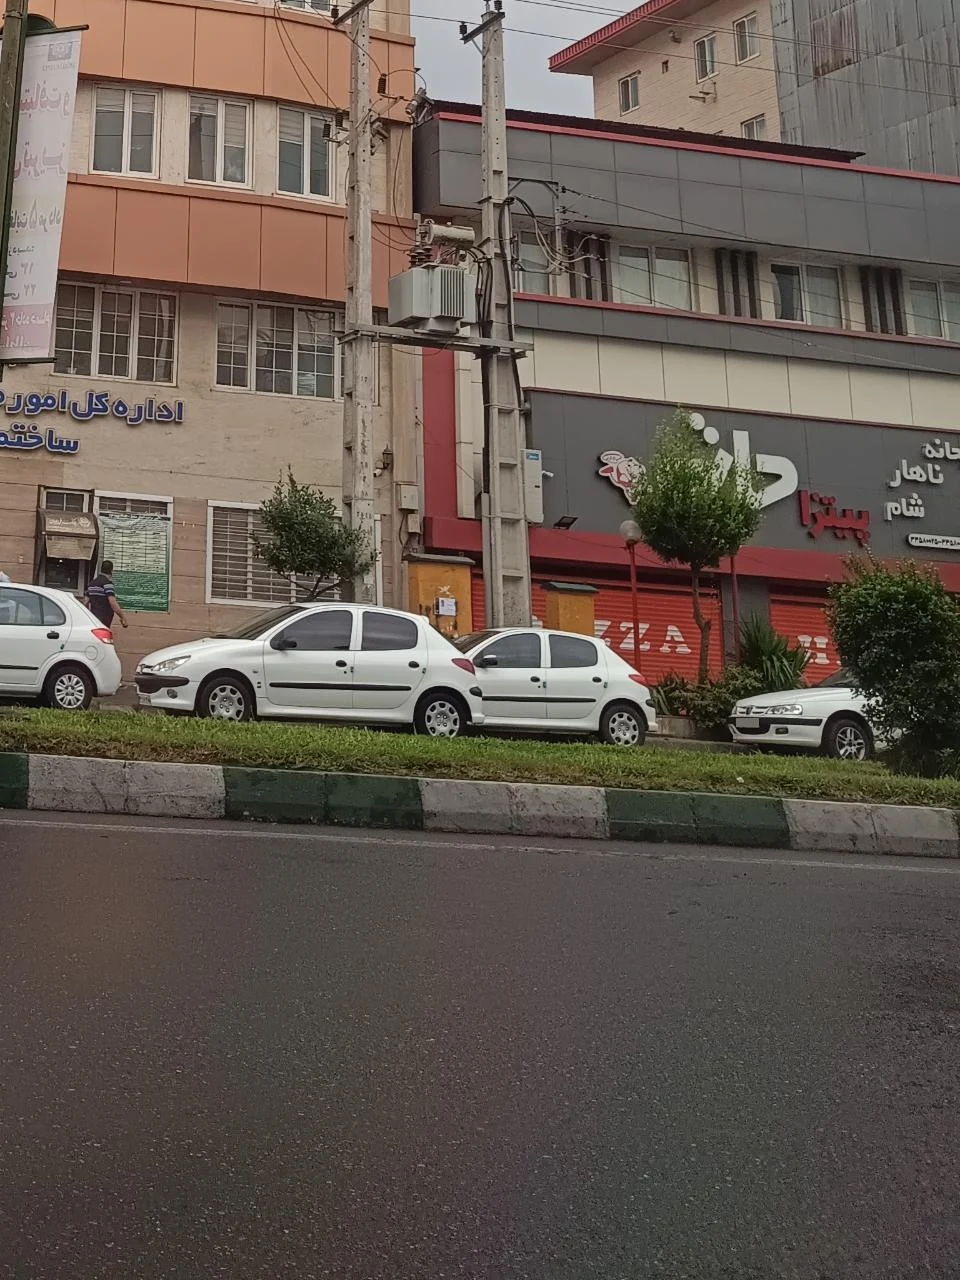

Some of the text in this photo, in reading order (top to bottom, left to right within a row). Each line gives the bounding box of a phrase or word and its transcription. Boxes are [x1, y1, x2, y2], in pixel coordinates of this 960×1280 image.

[6, 388, 68, 415] امور
[70, 390, 109, 420] کل
[113, 396, 184, 425] اداره
[924, 438, 960, 461] حانه
[888, 458, 945, 488] ناهار
[798, 488, 871, 547] پیتزا
[886, 492, 926, 522] شام
